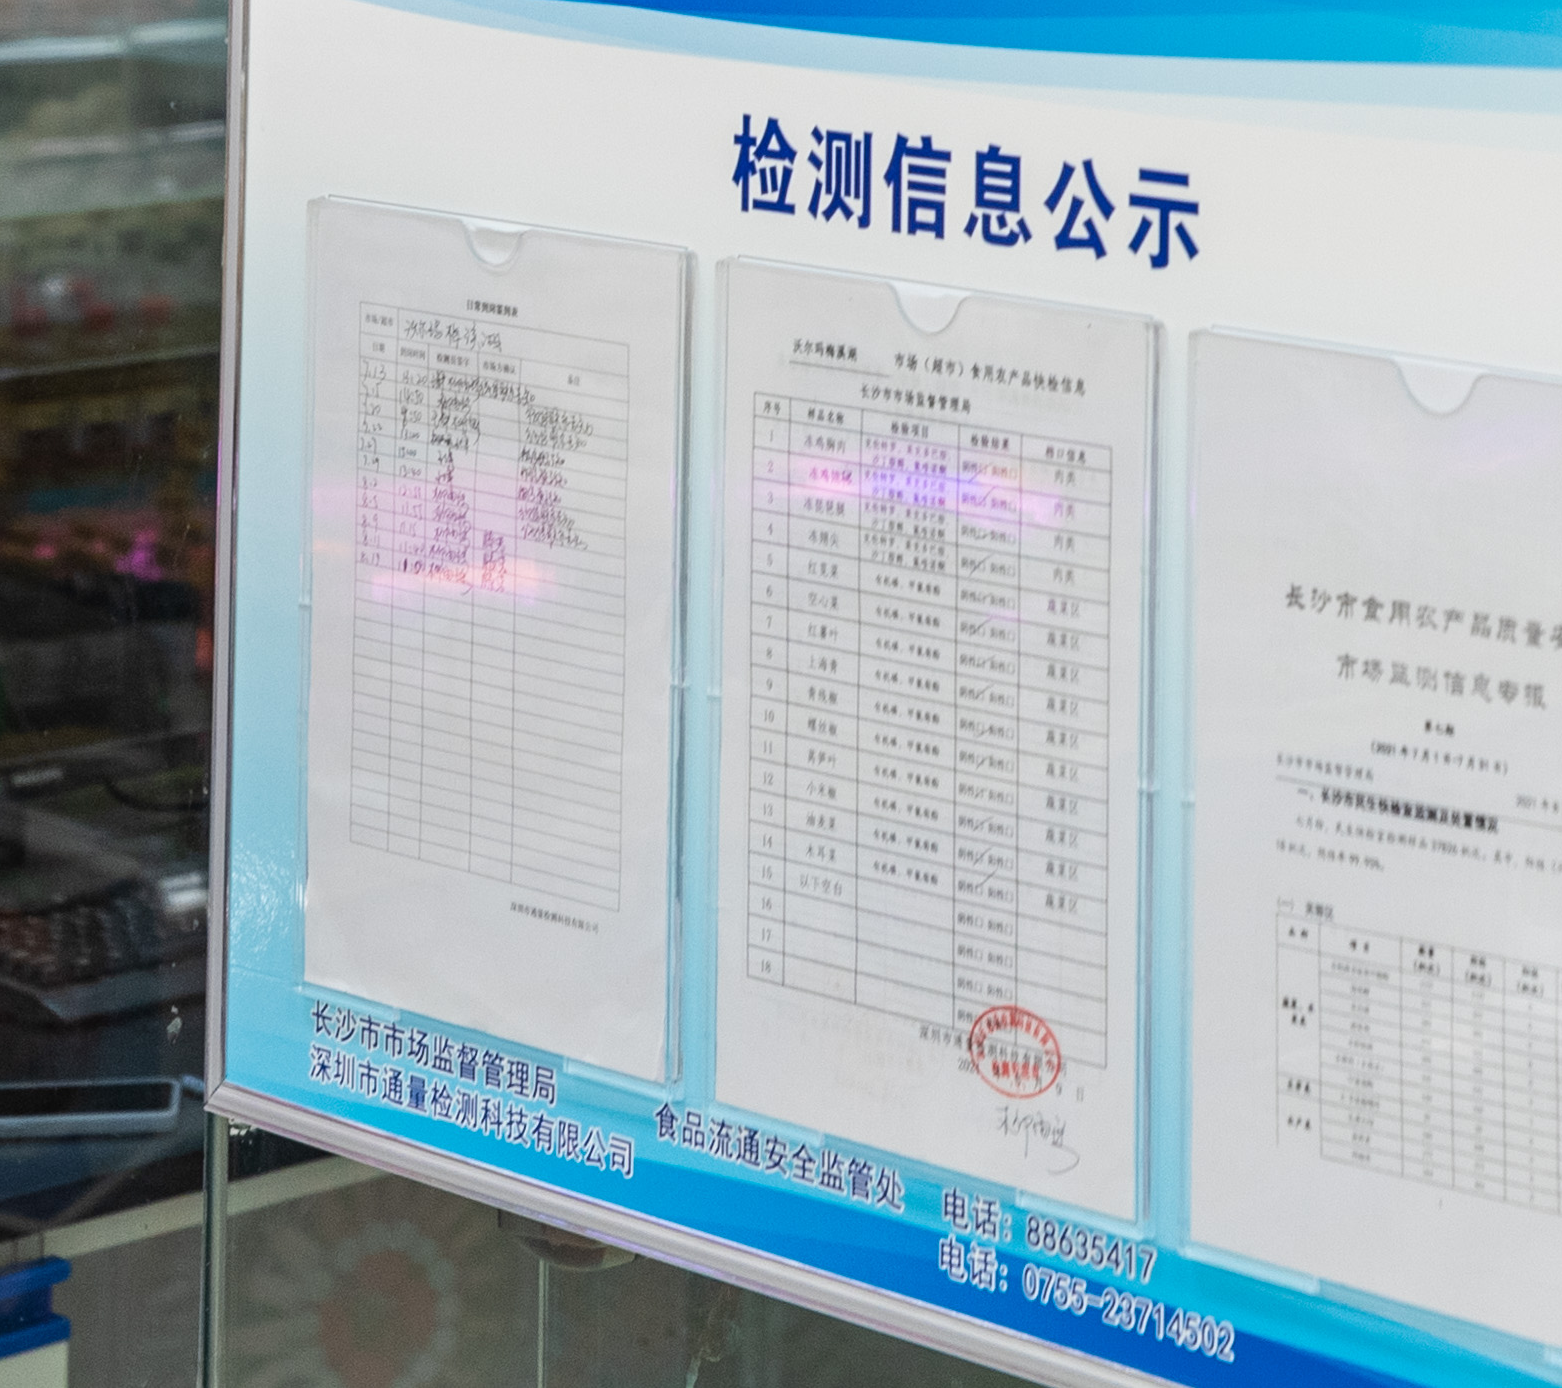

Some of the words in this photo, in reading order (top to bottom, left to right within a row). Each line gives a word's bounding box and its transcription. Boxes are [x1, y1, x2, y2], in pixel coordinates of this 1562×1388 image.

[732, 113, 1202, 272] 检测信息公示
[308, 1043, 635, 1179] 深圳市通量检测科技有限公司
[310, 998, 557, 1106] 长沙市市场监督管理局
[653, 1100, 907, 1213] 食品流通安全监管处
